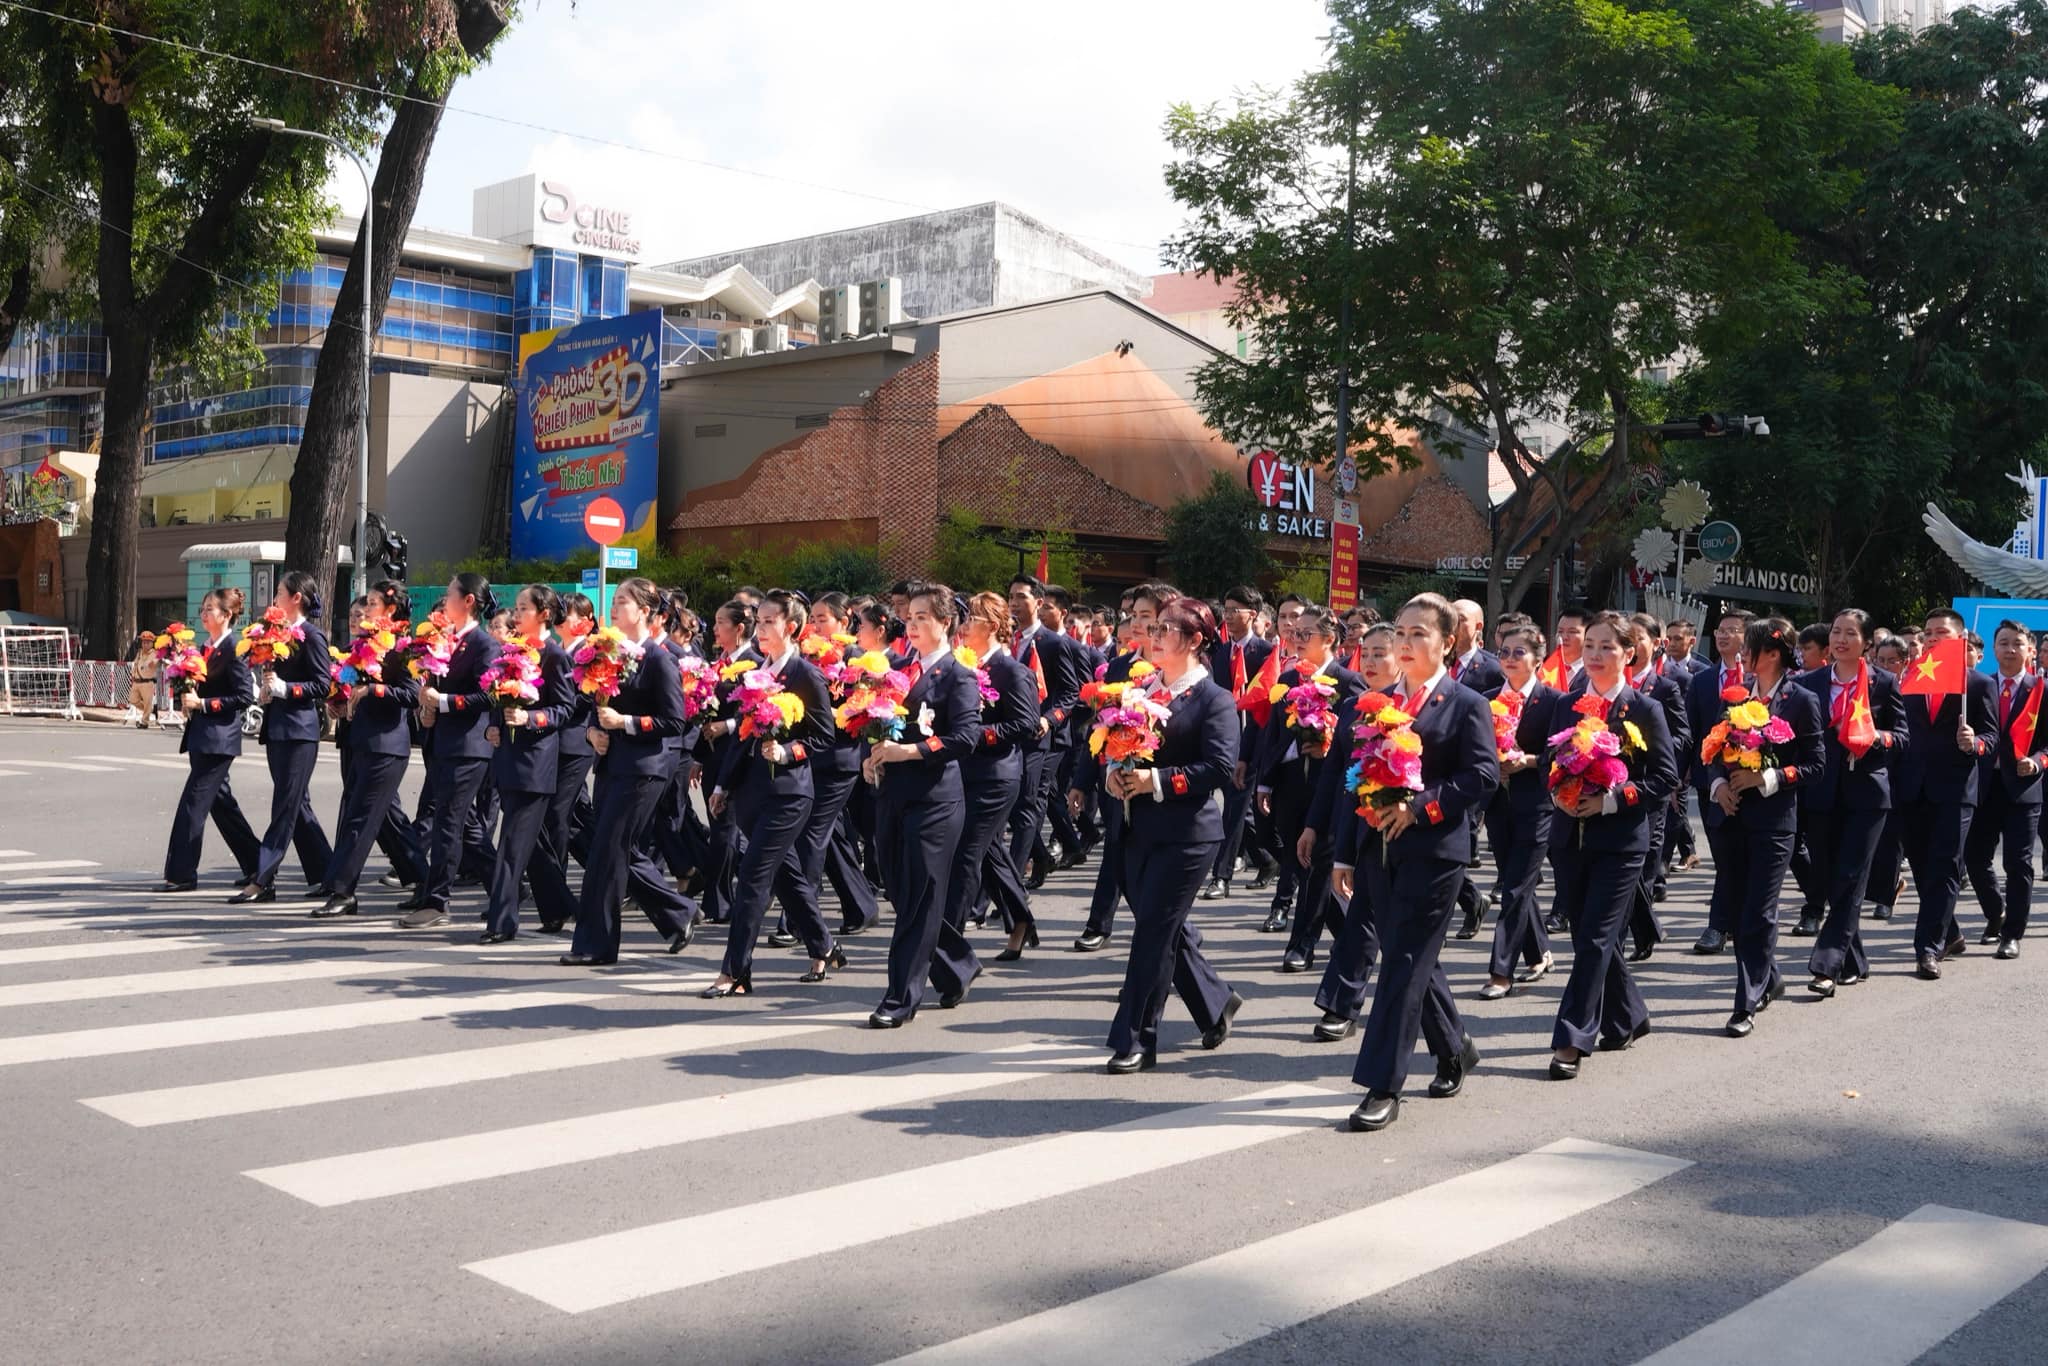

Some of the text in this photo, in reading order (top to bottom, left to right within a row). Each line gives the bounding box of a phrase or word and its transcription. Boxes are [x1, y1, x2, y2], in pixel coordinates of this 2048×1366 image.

[573, 230, 640, 254] CINEMAS
[553, 361, 647, 415] PHÒNG 3D
[537, 401, 597, 435] CHIẾU PHIM
[631, 418, 642, 434] phí
[560, 459, 621, 490] Thiếu Nhi
[1259, 513, 1270, 532] &
[1277, 514, 1326, 539] SAKE
[1702, 537, 1727, 549] BIDV
[1471, 556, 1526, 570] COEE
[1713, 563, 1788, 592] GHLANDS
